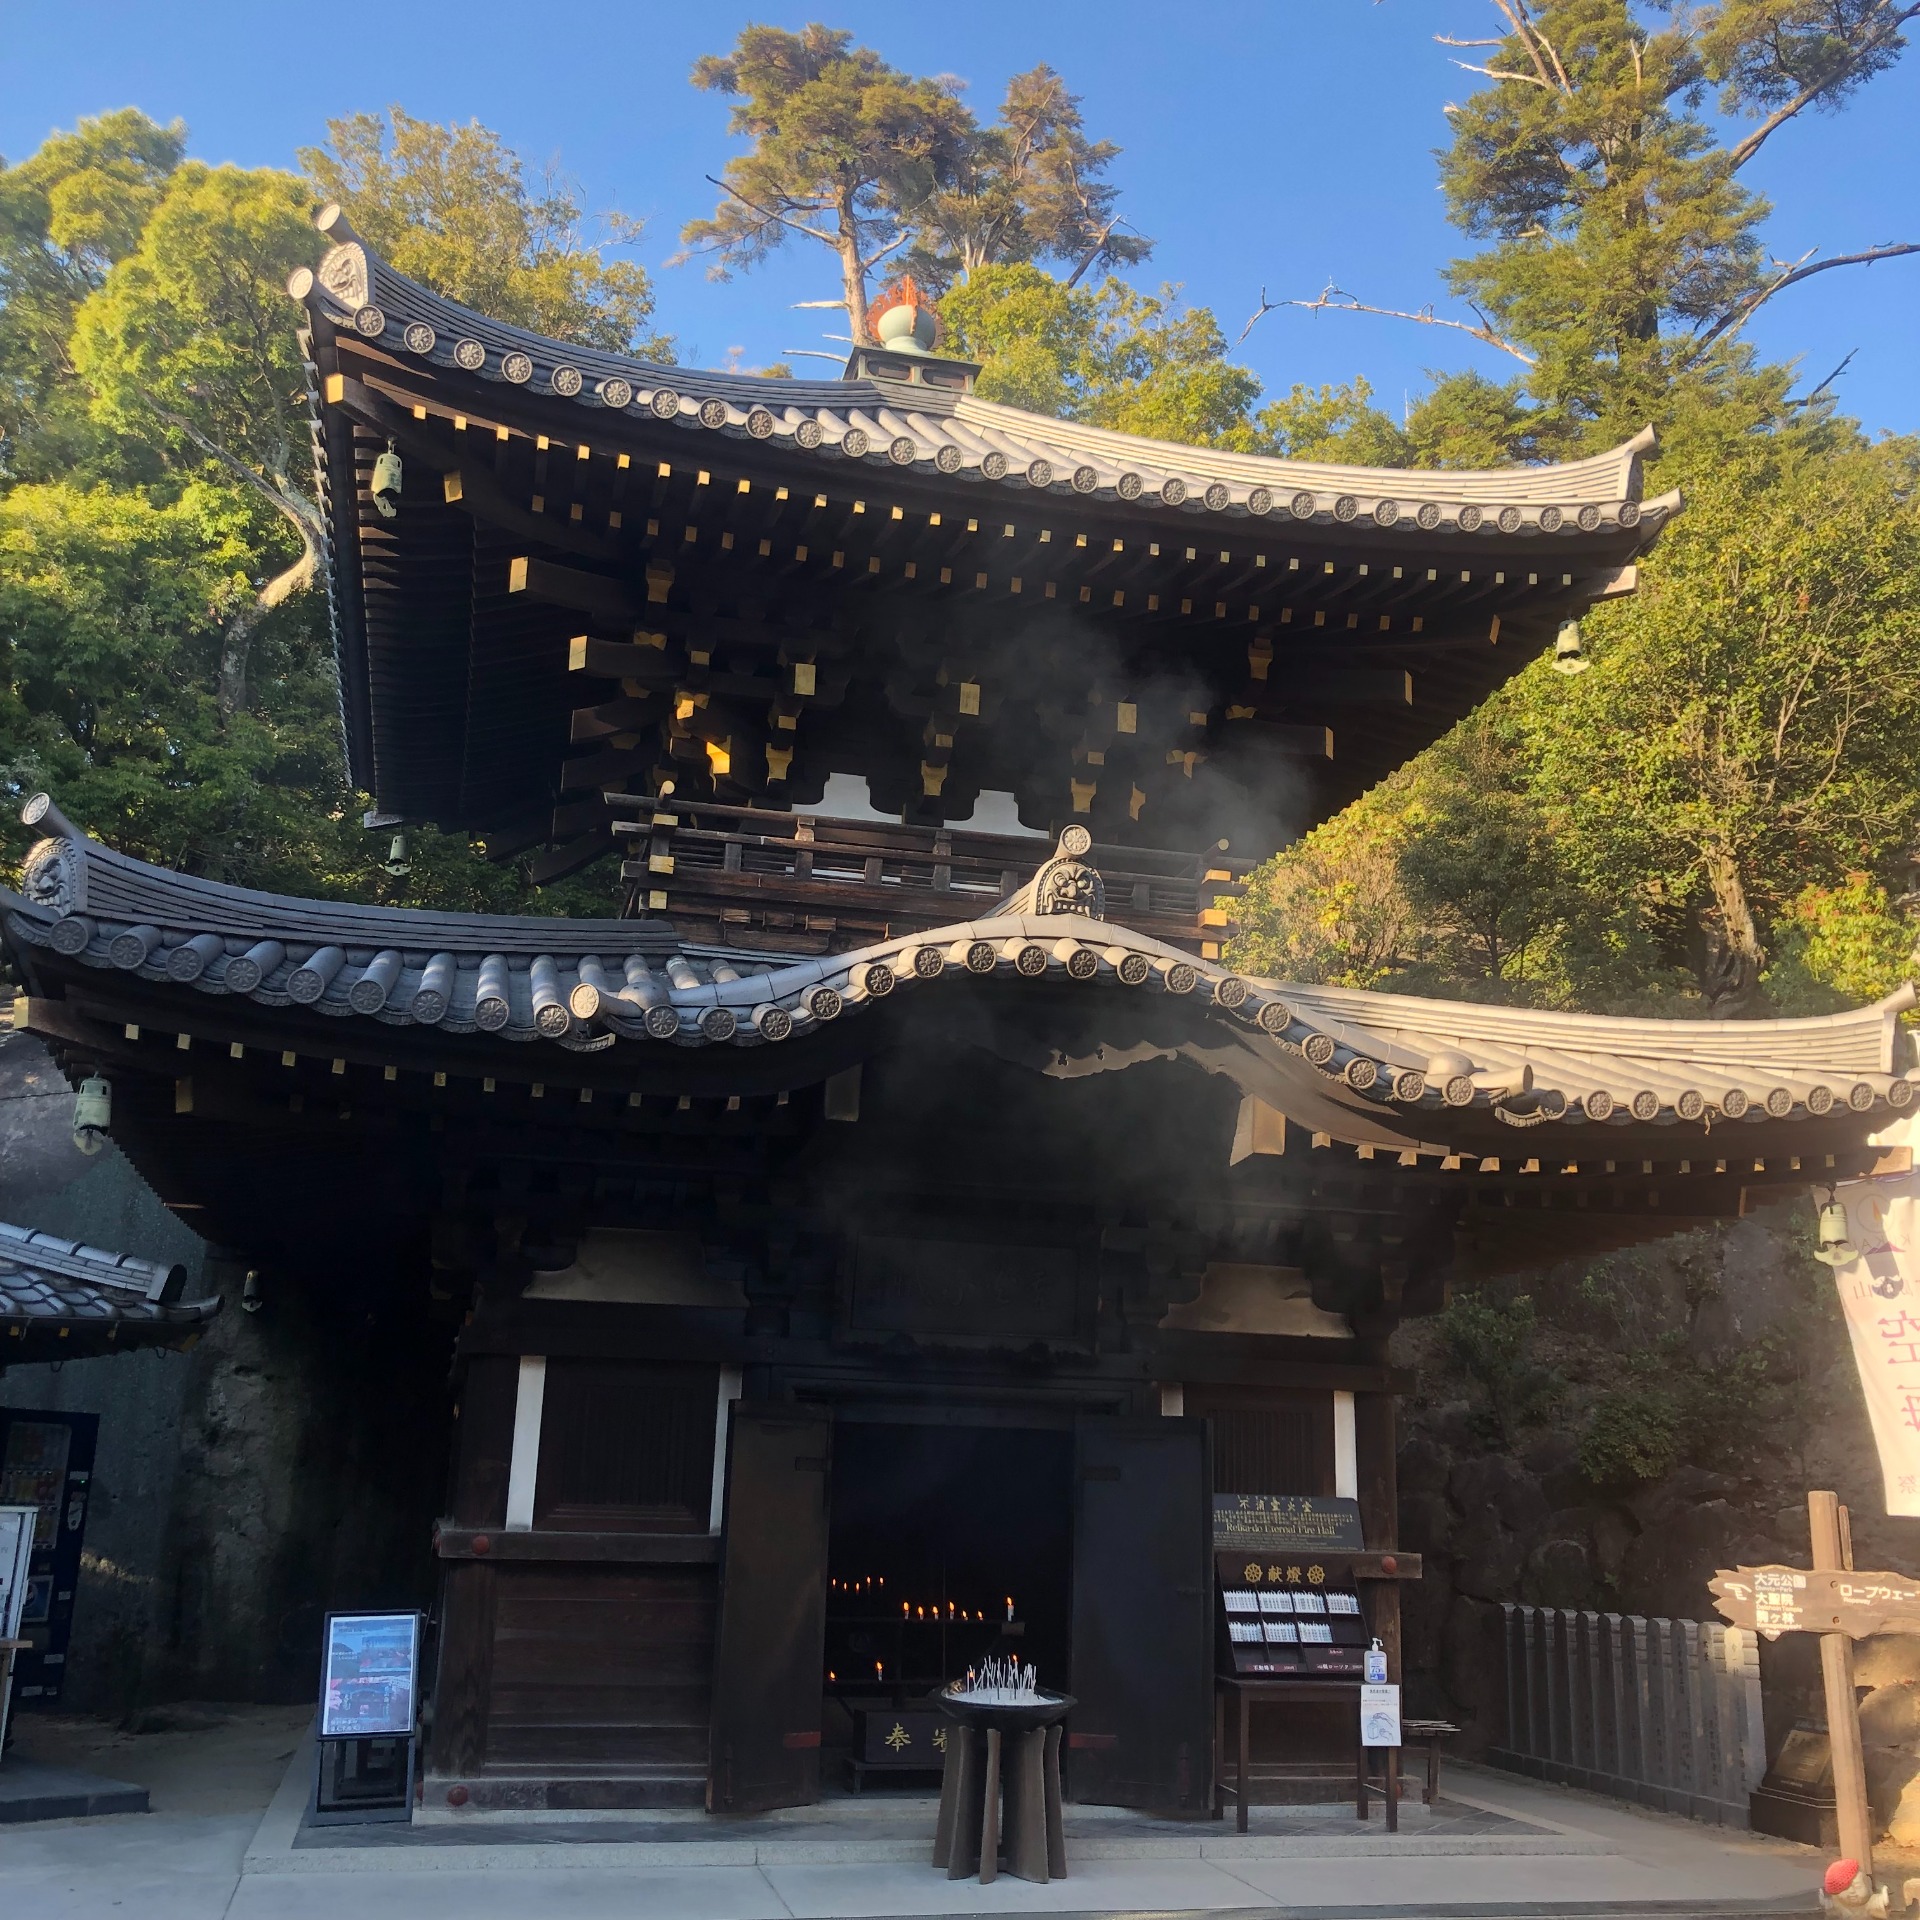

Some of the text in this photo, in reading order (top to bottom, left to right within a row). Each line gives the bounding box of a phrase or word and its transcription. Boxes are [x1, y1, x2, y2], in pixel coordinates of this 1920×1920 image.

[1264, 1524, 1296, 1534] Eternal
[1298, 1525, 1315, 1535] Fire
[1318, 1526, 1336, 1535] Hall
[1268, 1566, 1302, 1583] 献燈
[1753, 1572, 1807, 1588] 大元公園
